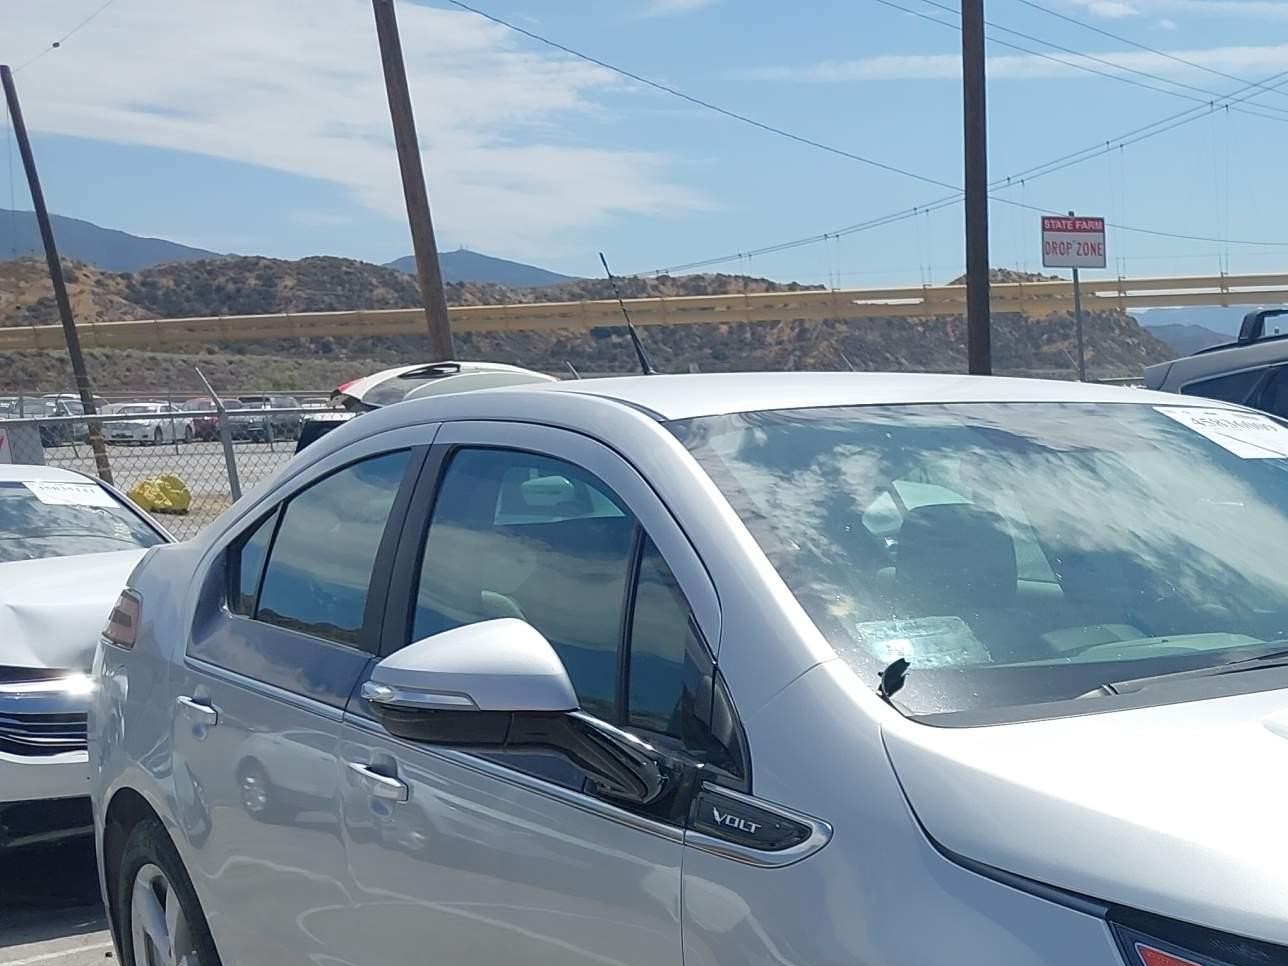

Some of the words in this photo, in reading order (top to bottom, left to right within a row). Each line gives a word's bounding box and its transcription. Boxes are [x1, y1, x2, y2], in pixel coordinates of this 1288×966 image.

[1044, 220, 1073, 230] STATE
[1075, 220, 1103, 230] FARM
[1045, 241, 1073, 256] DROP
[1076, 242, 1103, 257] ZONE
[713, 807, 762, 834] VOLT
